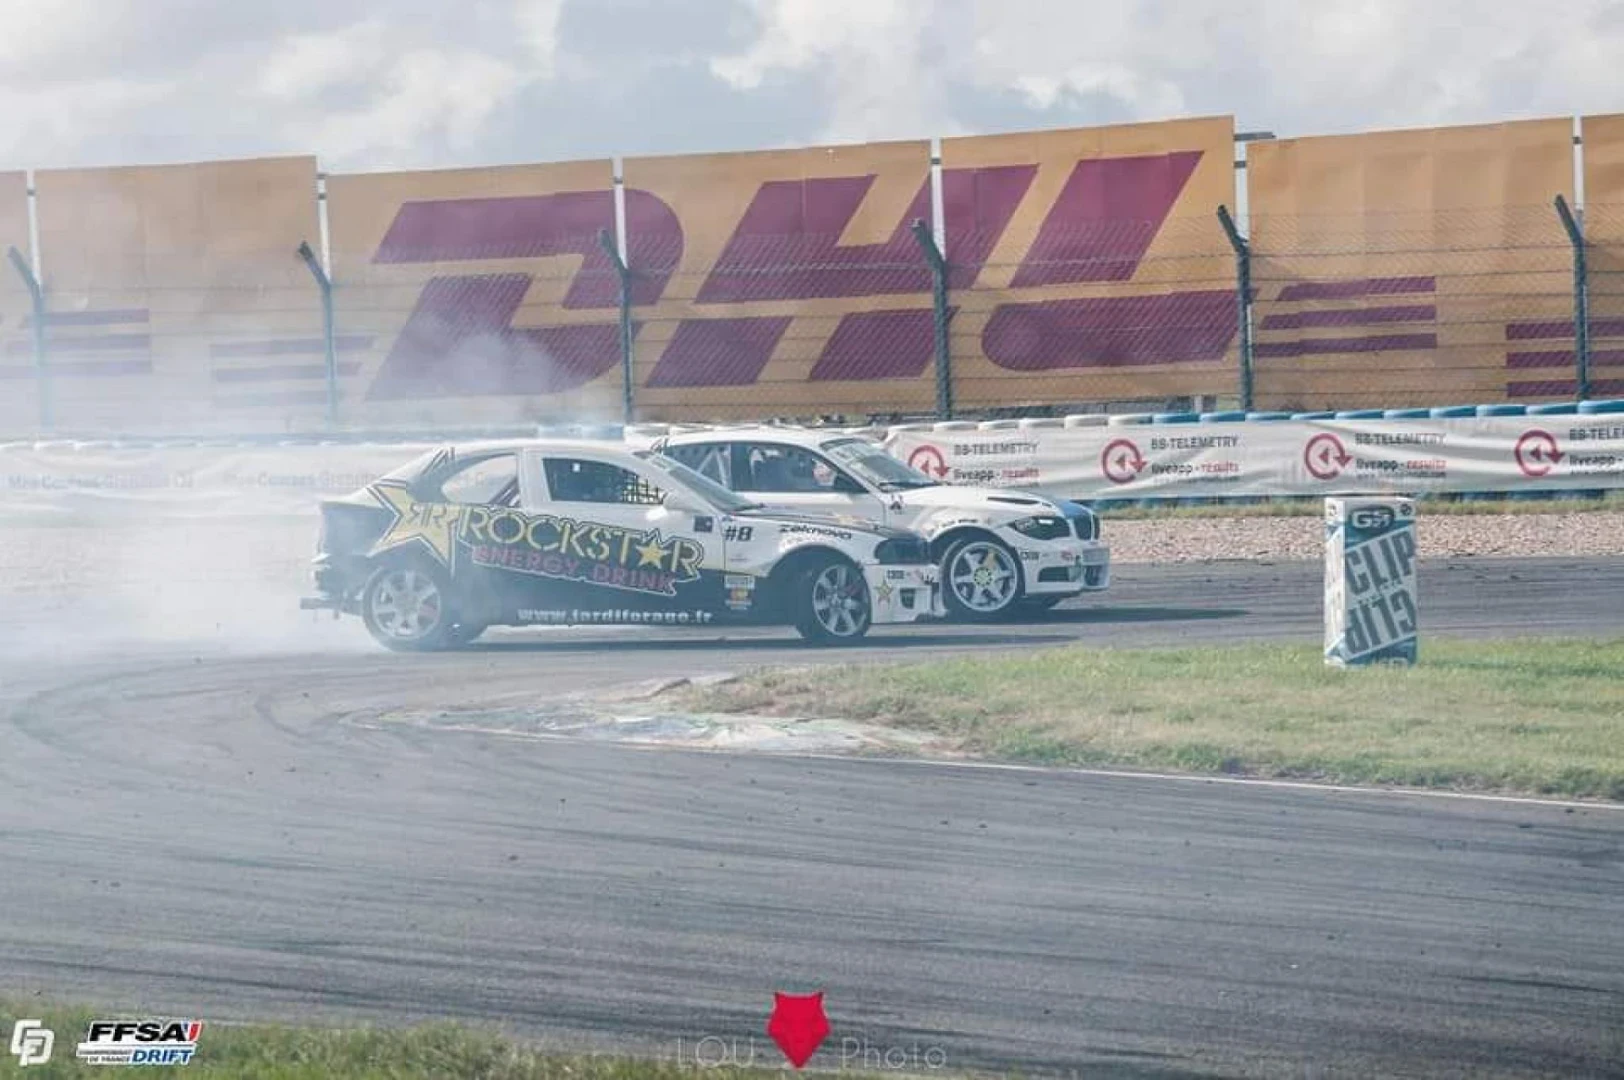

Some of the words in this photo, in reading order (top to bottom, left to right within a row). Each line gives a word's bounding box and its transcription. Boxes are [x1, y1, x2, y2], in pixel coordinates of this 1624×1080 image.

[366, 151, 1240, 400] DHL
[459, 505, 702, 579] ROCKSTAR
[725, 525, 753, 541] #8
[1346, 530, 1416, 595] CLIP
[473, 545, 581, 577] ENERGY
[591, 563, 677, 595] DRINK
[1346, 588, 1417, 655] CLIP
